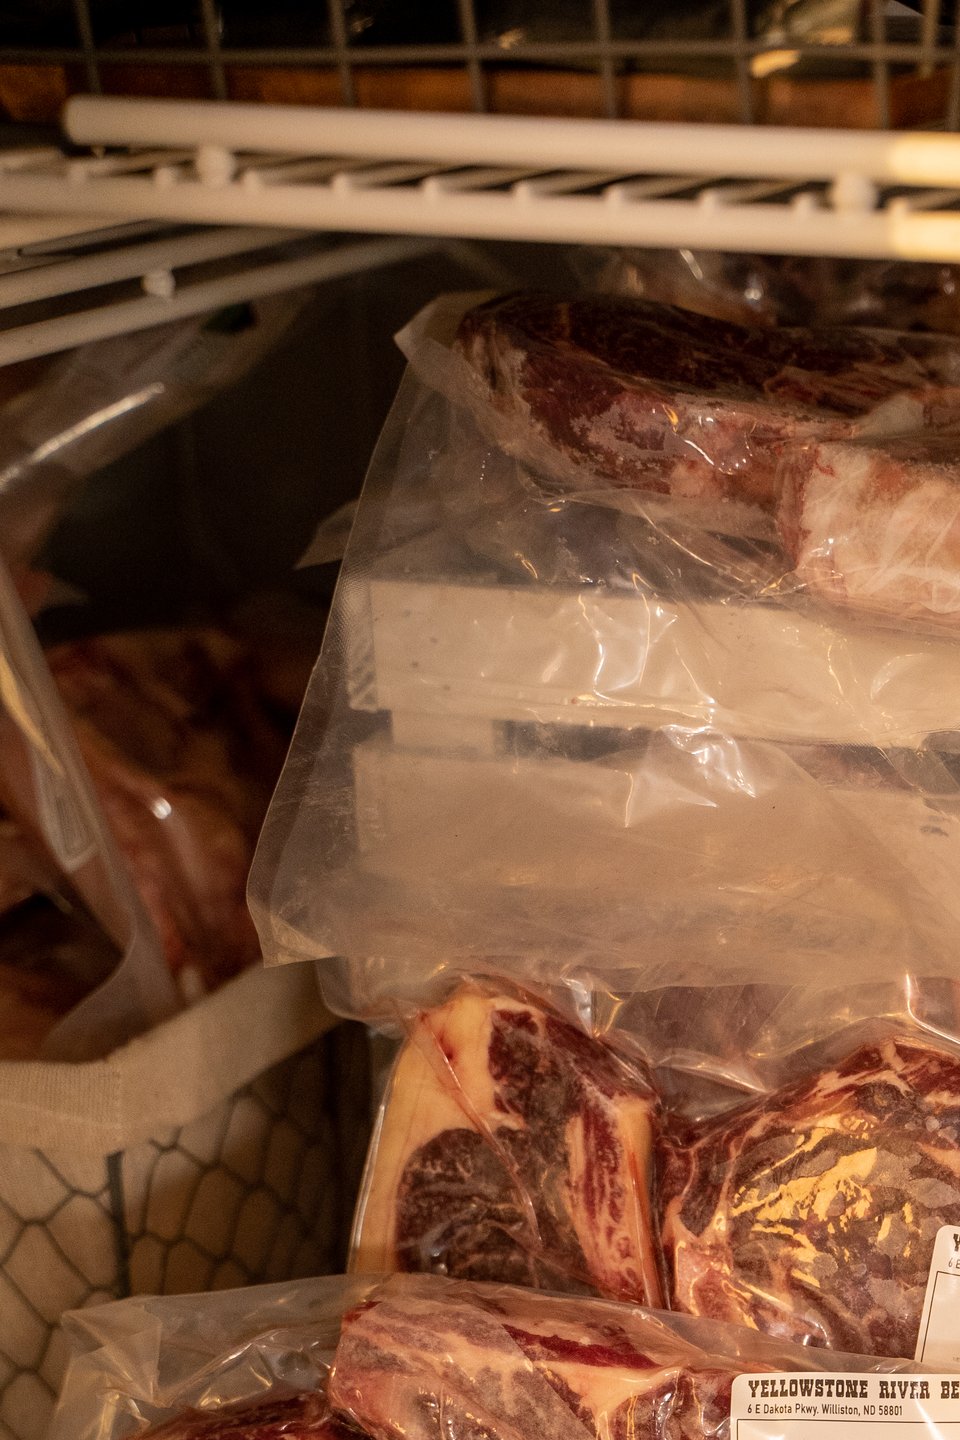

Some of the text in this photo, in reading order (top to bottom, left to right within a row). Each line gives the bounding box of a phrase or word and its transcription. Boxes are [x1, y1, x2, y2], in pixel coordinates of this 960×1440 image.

[955, 1259, 960, 1270] E
[748, 1378, 869, 1399] YELLOWSTONE
[879, 1380, 930, 1399] RIVER
[747, 1403, 903, 1417] 6 E Dakota Pkwy. Williston, ND 58801
